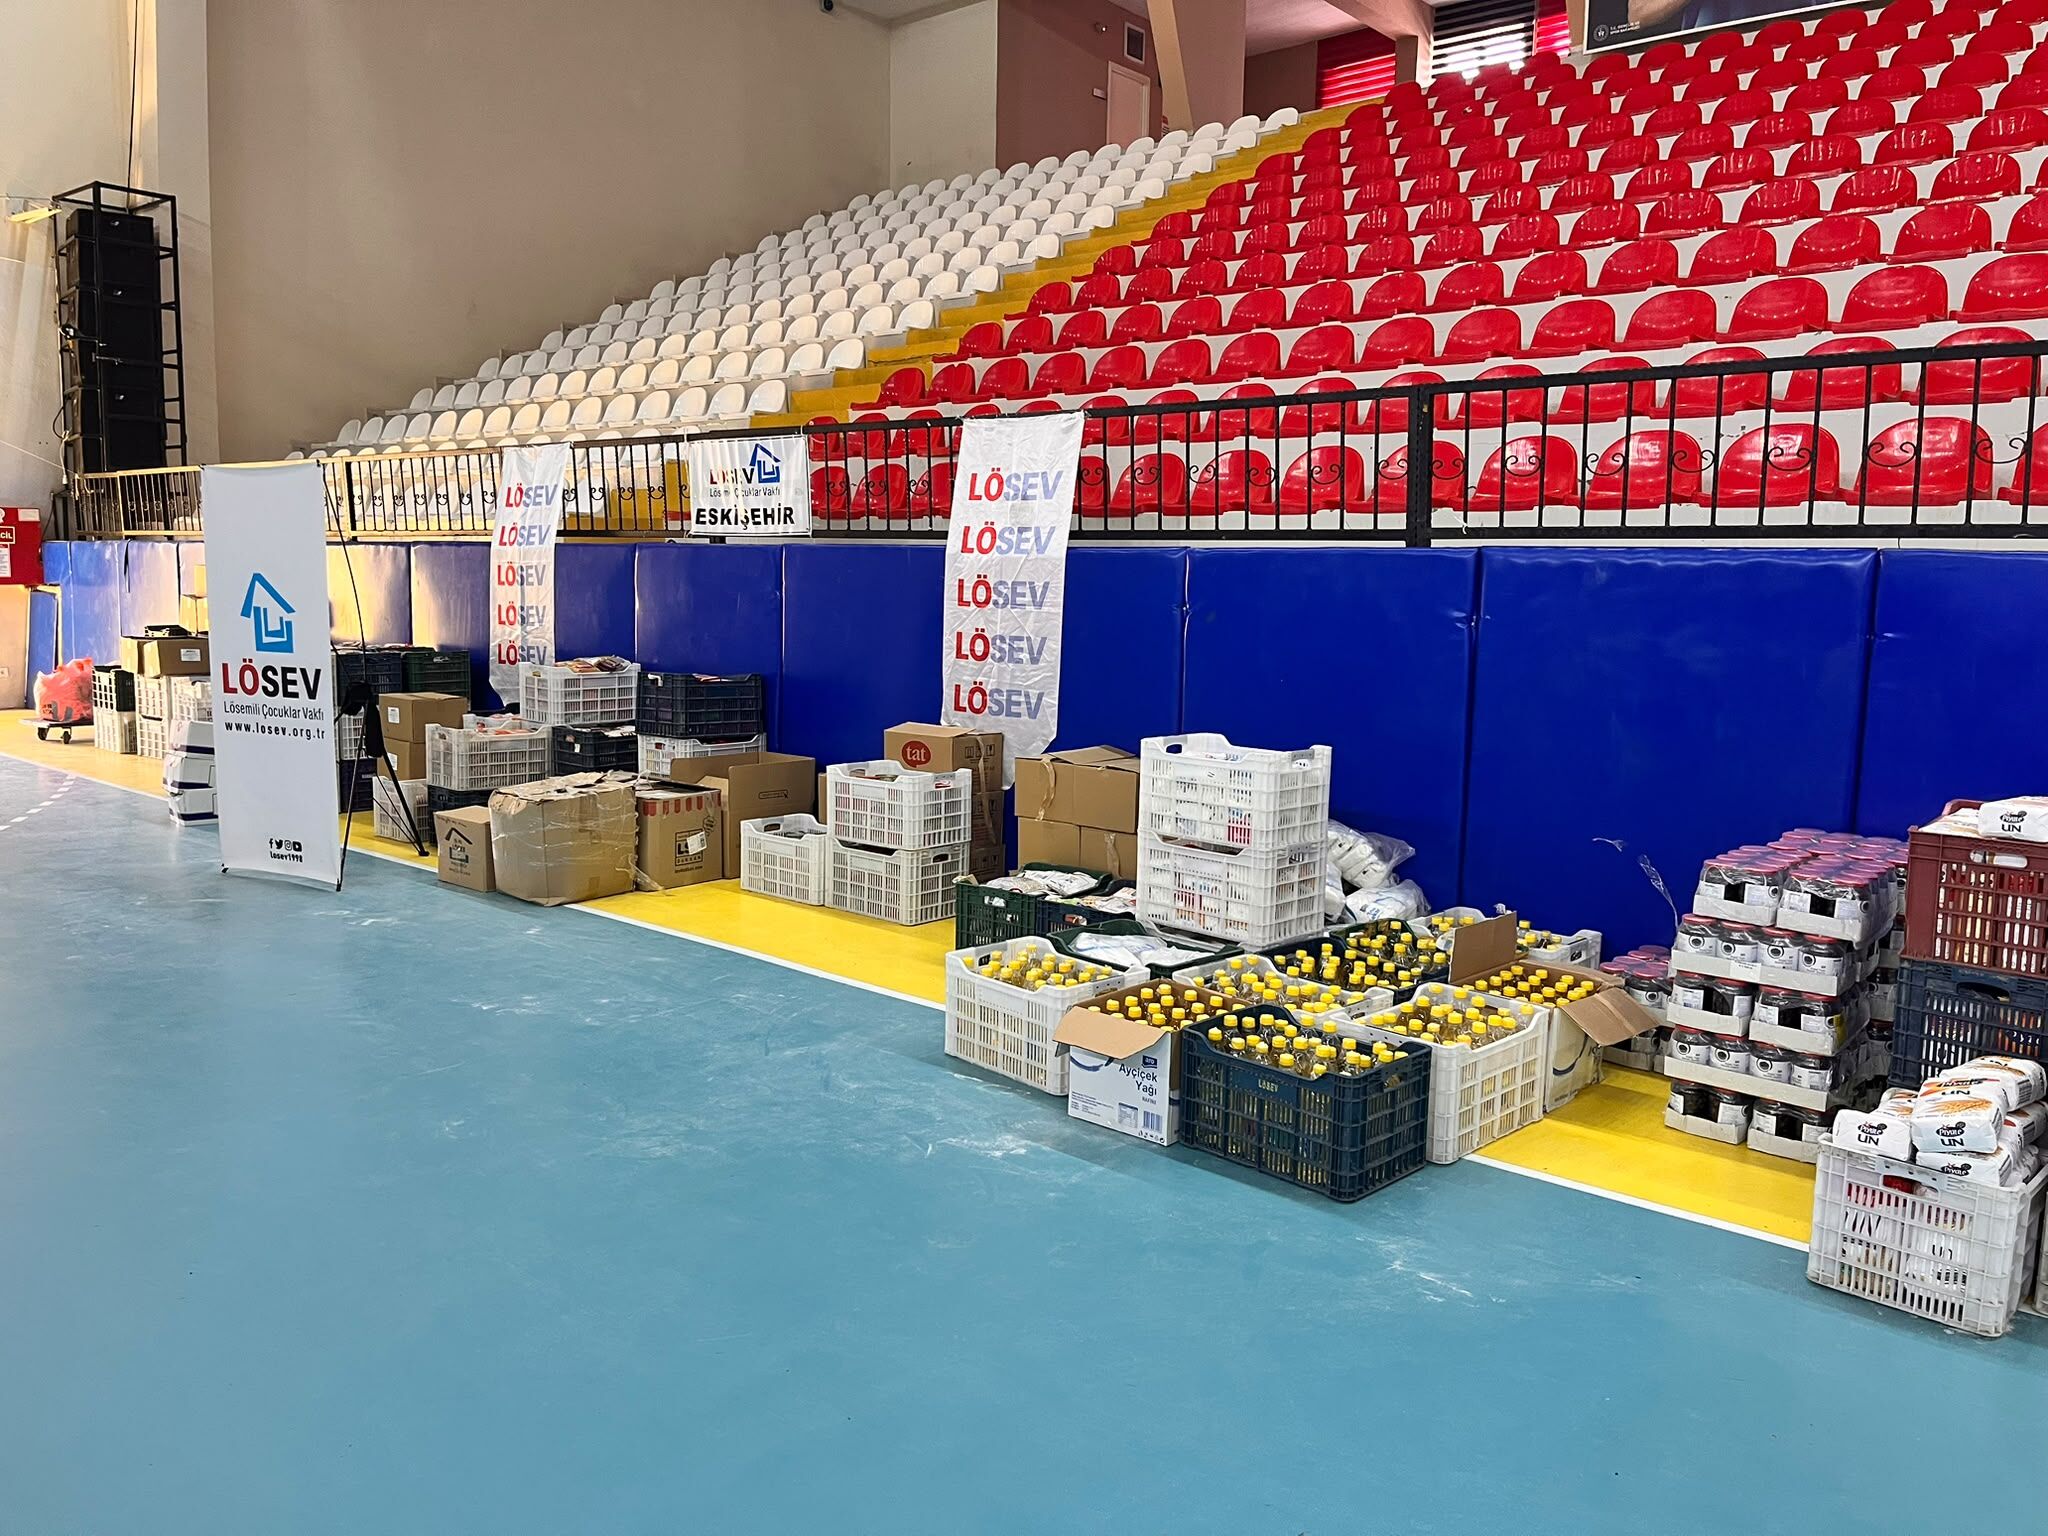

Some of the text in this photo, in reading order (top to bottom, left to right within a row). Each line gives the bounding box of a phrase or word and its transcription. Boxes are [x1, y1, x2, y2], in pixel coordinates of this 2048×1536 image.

[505, 482, 558, 507] LÖSEV
[968, 467, 1064, 502] LÖSEV
[695, 502, 795, 531] ESKİŞEHİR
[498, 522, 551, 547] LÖSEV
[960, 521, 1056, 556] LÖSEV
[497, 561, 546, 587] LÖSEV
[957, 574, 1050, 610] LÖSEV
[497, 601, 547, 627] LÖSEV
[497, 640, 548, 666] LÖSEV
[955, 627, 1047, 666] LÖSEV
[222, 658, 322, 700] LÖSEV
[223, 701, 324, 720] Lösemili Çocuklar Vakfı
[953, 681, 1045, 720] LÖSEV
[224, 722, 325, 740] www.losev.org.tr
[906, 746, 926, 762] tat
[2001, 823, 2021, 833] UN
[1118, 1063, 1158, 1082] Ayçiçek
[1135, 1080, 1157, 1096] Yağı
[1857, 1133, 1880, 1146] UN
[1940, 1138, 1965, 1147] UN
